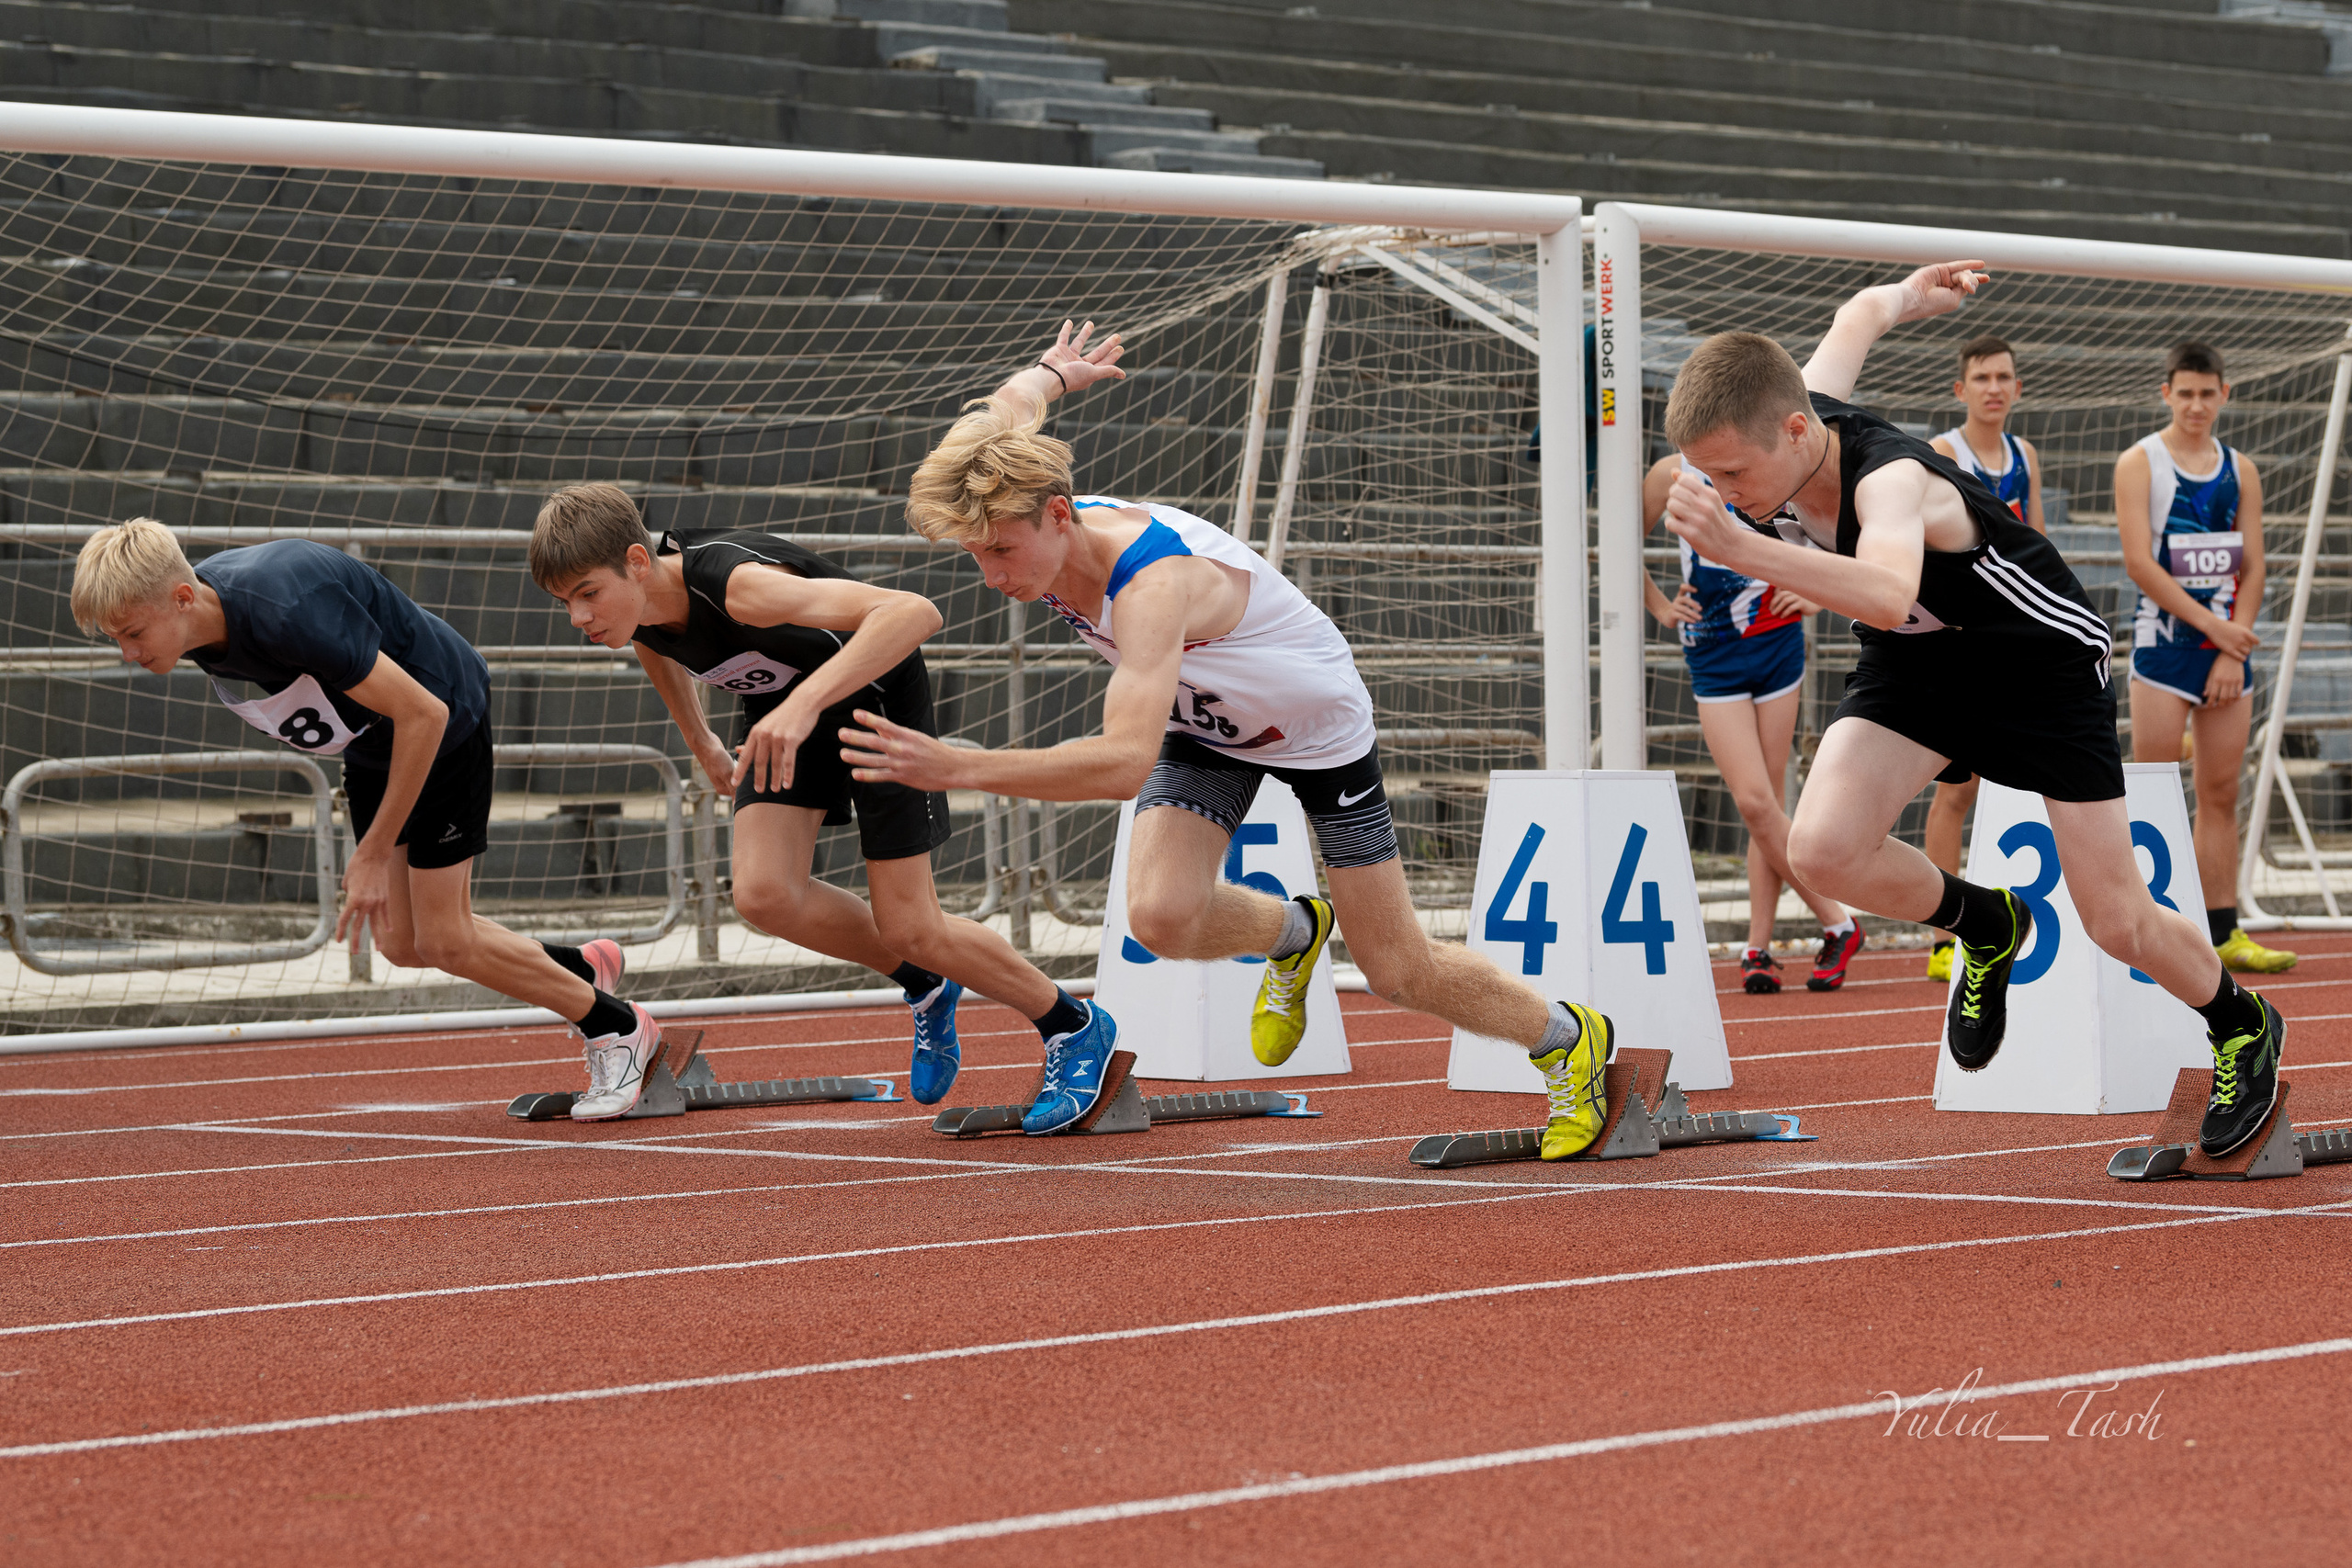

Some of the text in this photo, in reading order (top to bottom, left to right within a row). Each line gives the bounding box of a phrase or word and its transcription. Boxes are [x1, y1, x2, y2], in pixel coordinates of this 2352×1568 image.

[1600, 258, 1614, 379] SPORTWERK
[2182, 548, 2232, 574] 109
[272, 706, 334, 749] 8
[707, 669, 776, 691] 69
[1484, 822, 1558, 976] 4
[1601, 822, 1675, 976] 4
[1997, 821, 2062, 985] 3
